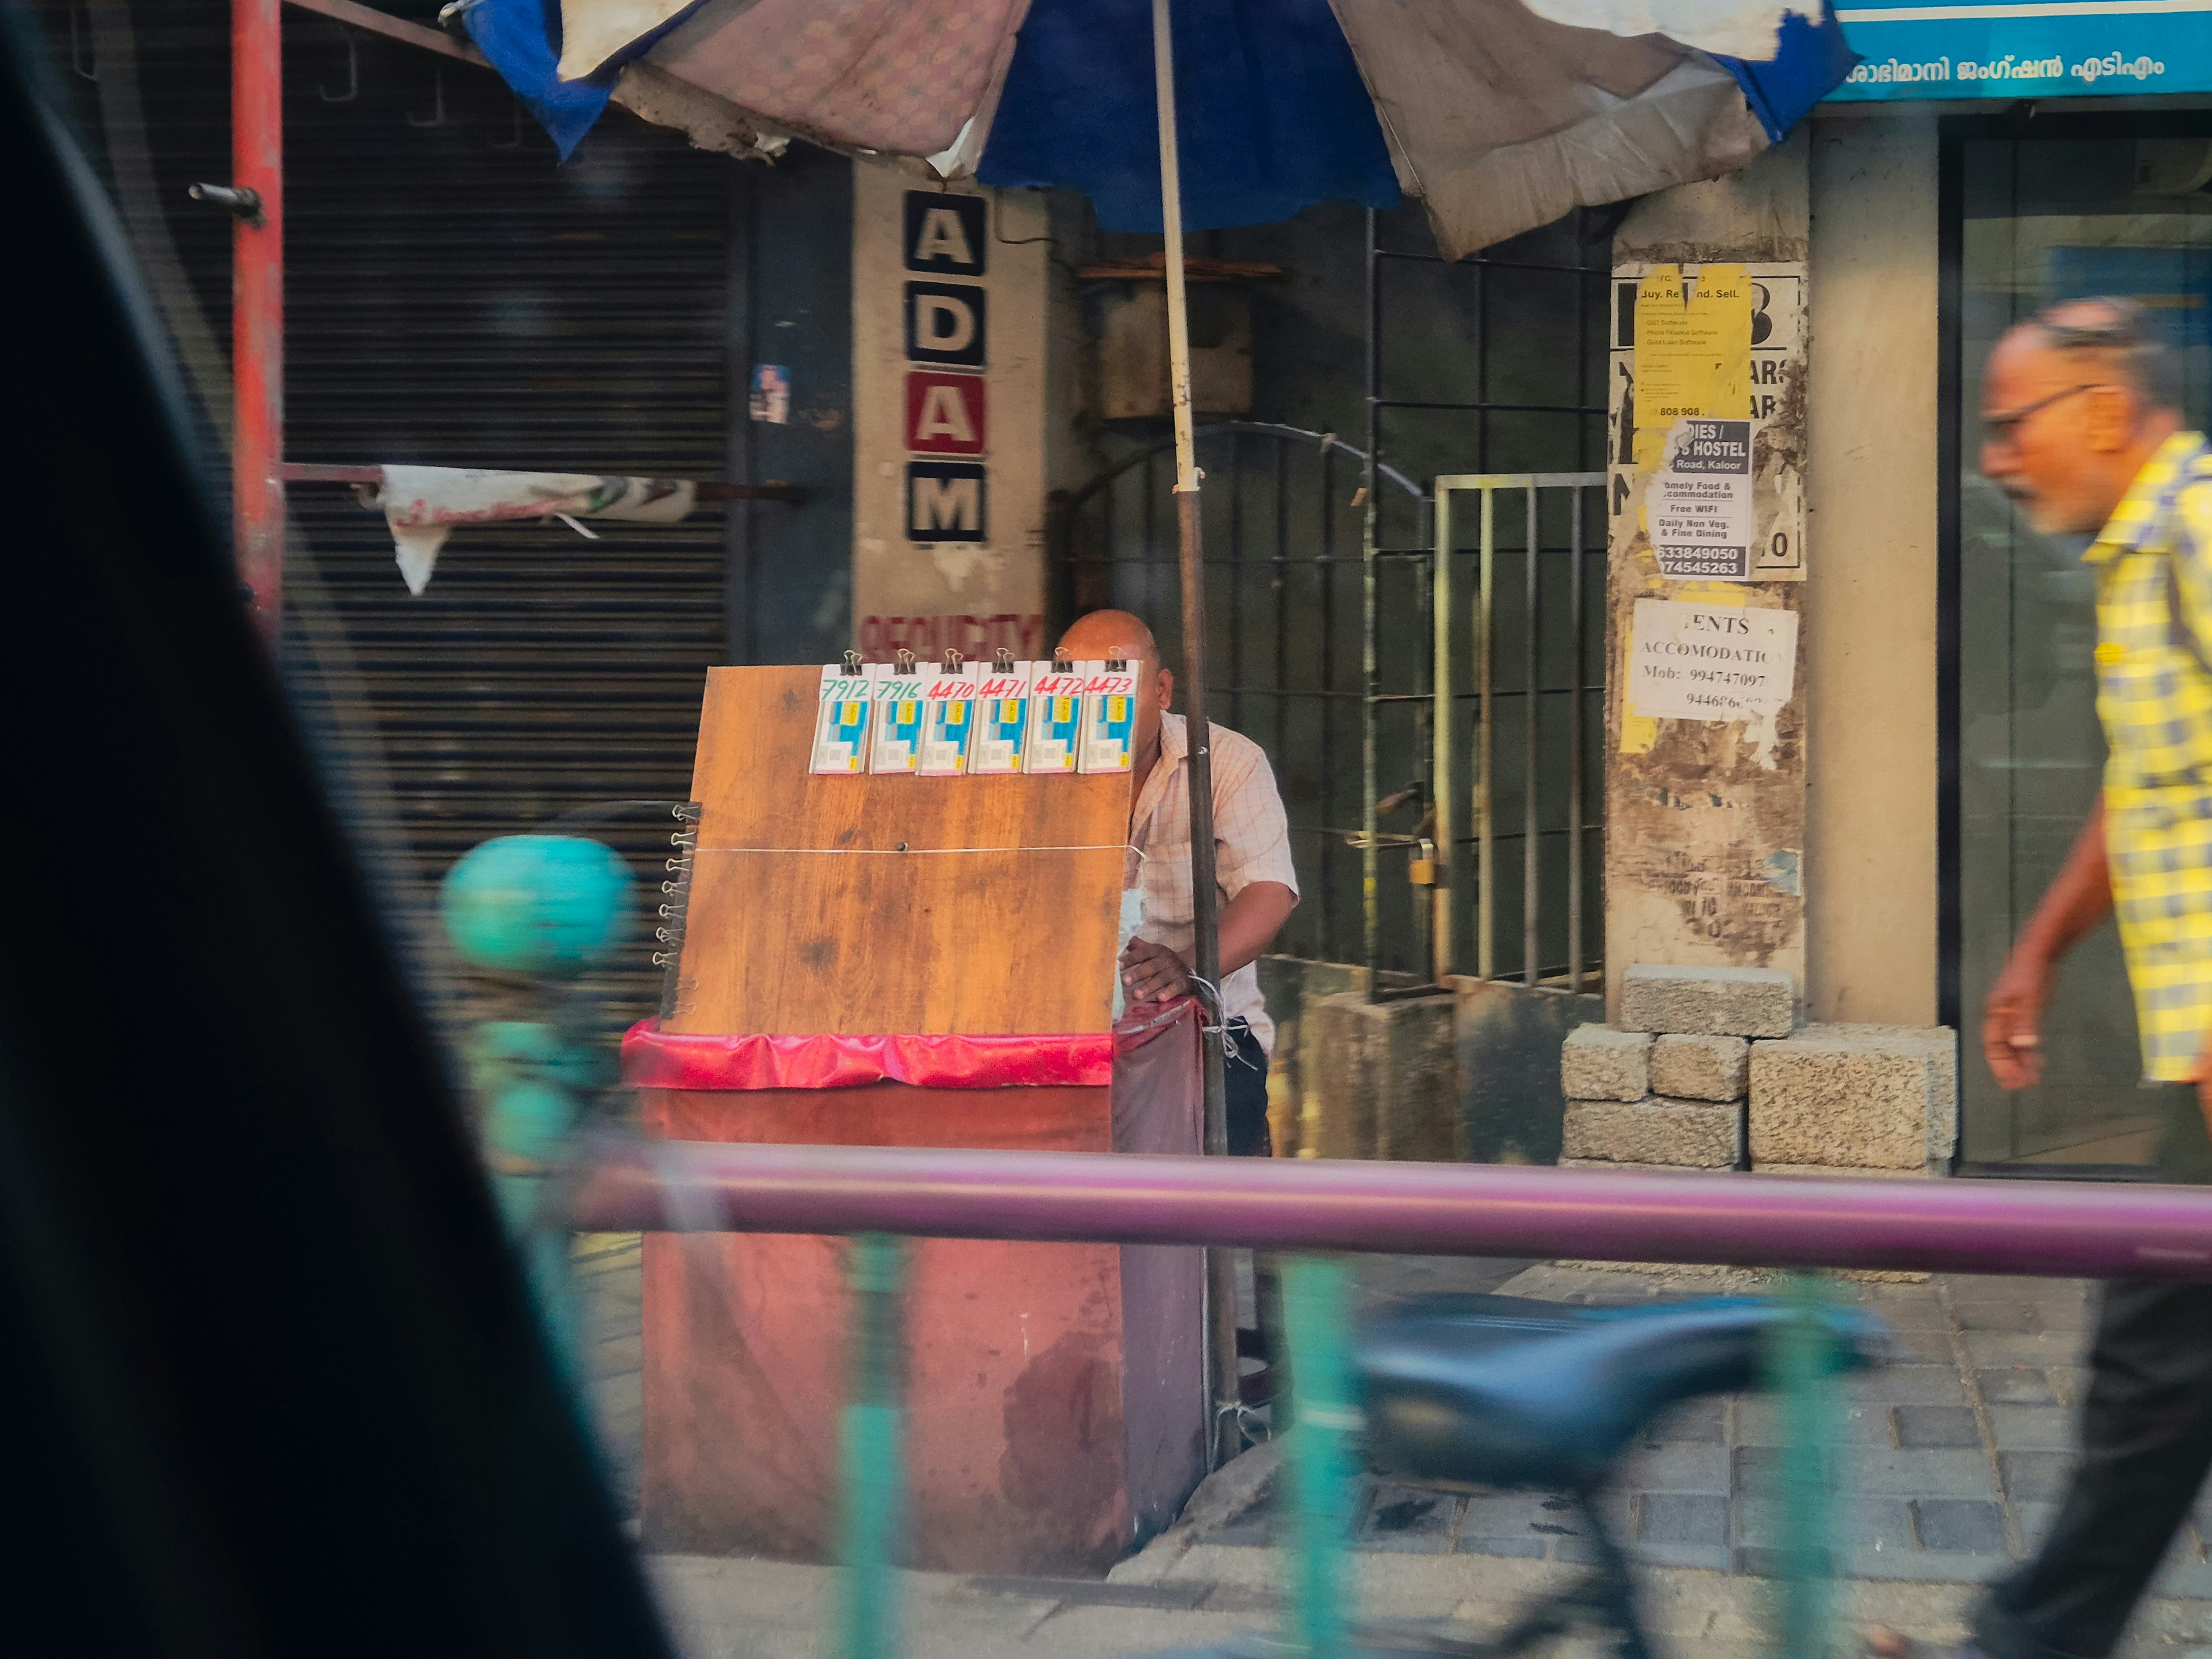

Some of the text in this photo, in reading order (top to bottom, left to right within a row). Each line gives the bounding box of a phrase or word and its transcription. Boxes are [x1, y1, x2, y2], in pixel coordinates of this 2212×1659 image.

[2071, 51, 2164, 81] എടിഎം
[913, 207, 978, 531] ADAM
[1693, 441, 1746, 457] HOSTEL
[1708, 461, 1741, 469] Kaloor
[1659, 519, 1683, 528] Daily
[1696, 530, 1727, 539] Dining
[822, 679, 869, 700] 7912
[877, 681, 922, 700] 7916
[926, 680, 975, 700] 4470
[978, 678, 1026, 698] 4471
[1034, 676, 1085, 695] 4472
[1083, 676, 1133, 693] 4473
